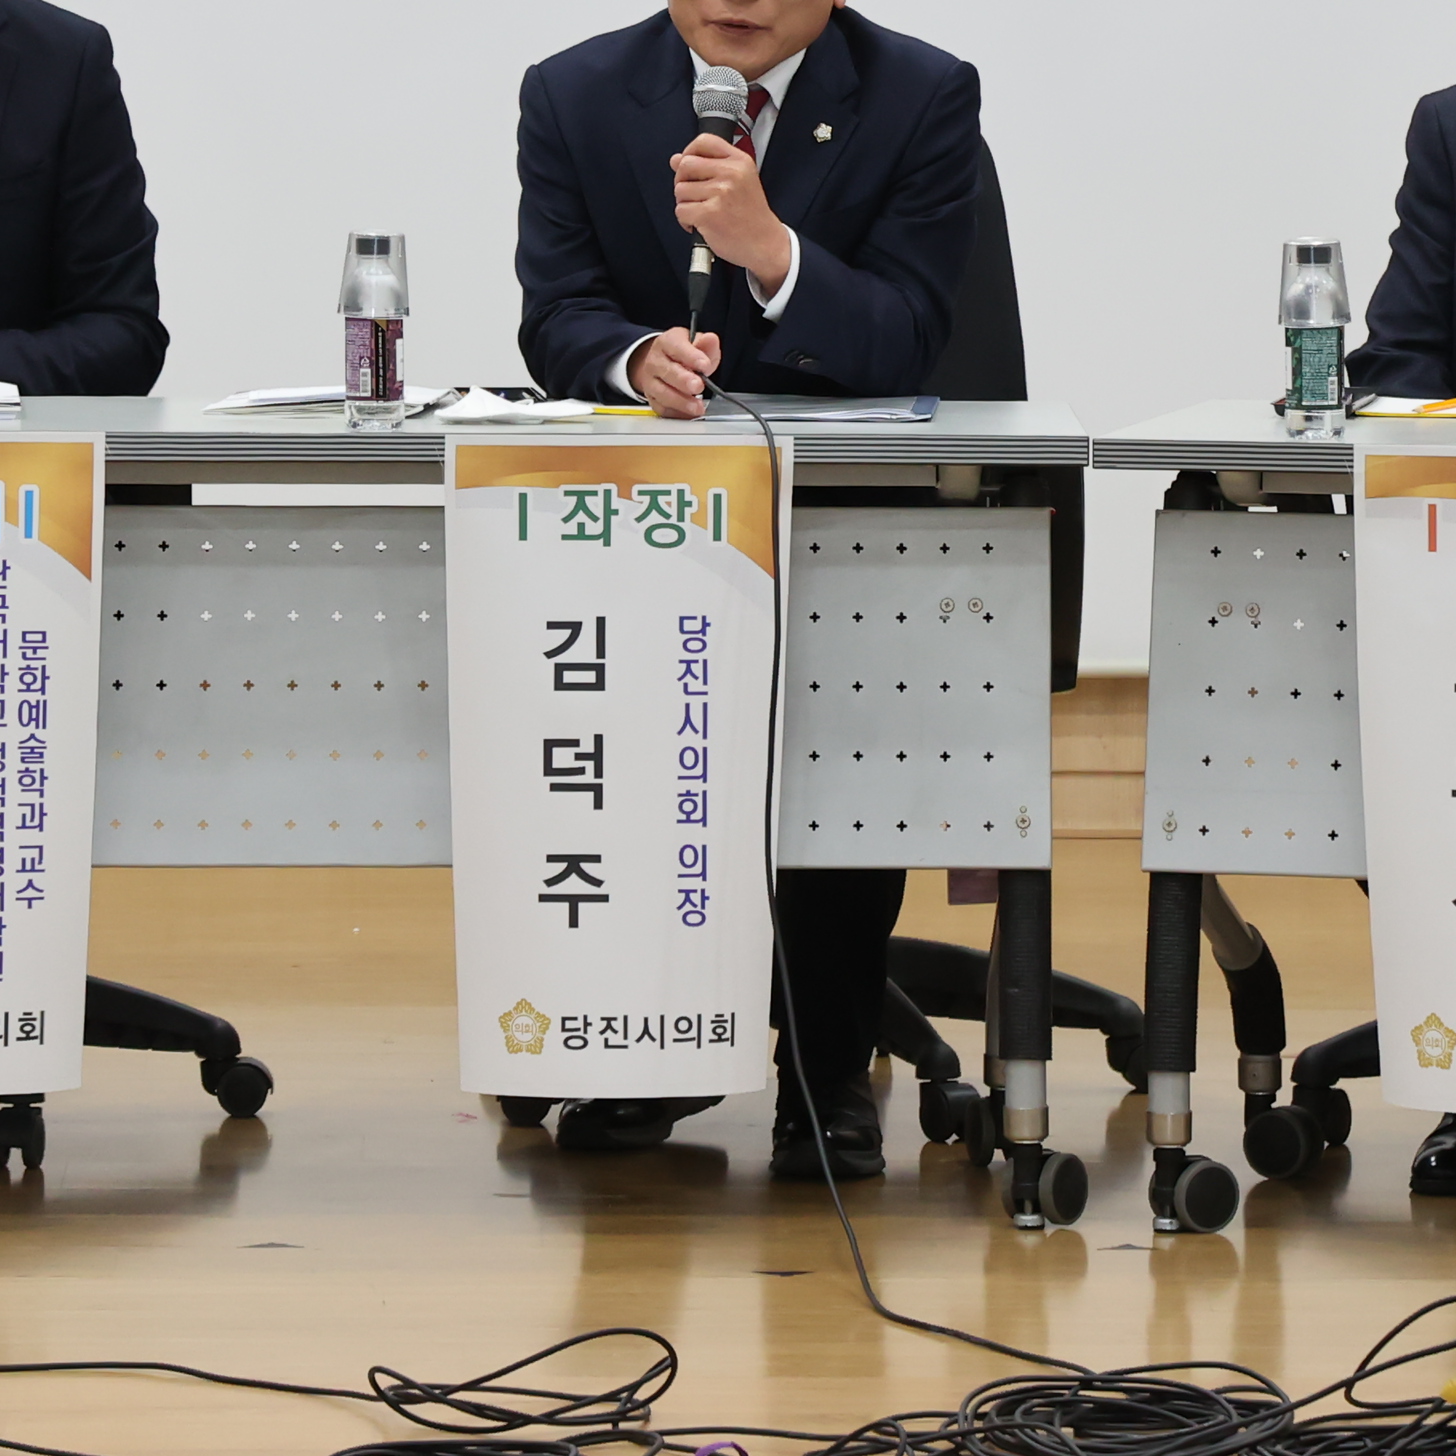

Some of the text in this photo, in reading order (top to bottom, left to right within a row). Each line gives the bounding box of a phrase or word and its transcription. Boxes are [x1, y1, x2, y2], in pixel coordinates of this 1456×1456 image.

[563, 490, 693, 548] 좌장
[15, 630, 52, 911] 문화예술학과 교수
[676, 614, 713, 929] 당진시의회 의장
[561, 1012, 736, 1052] 당진시의회
